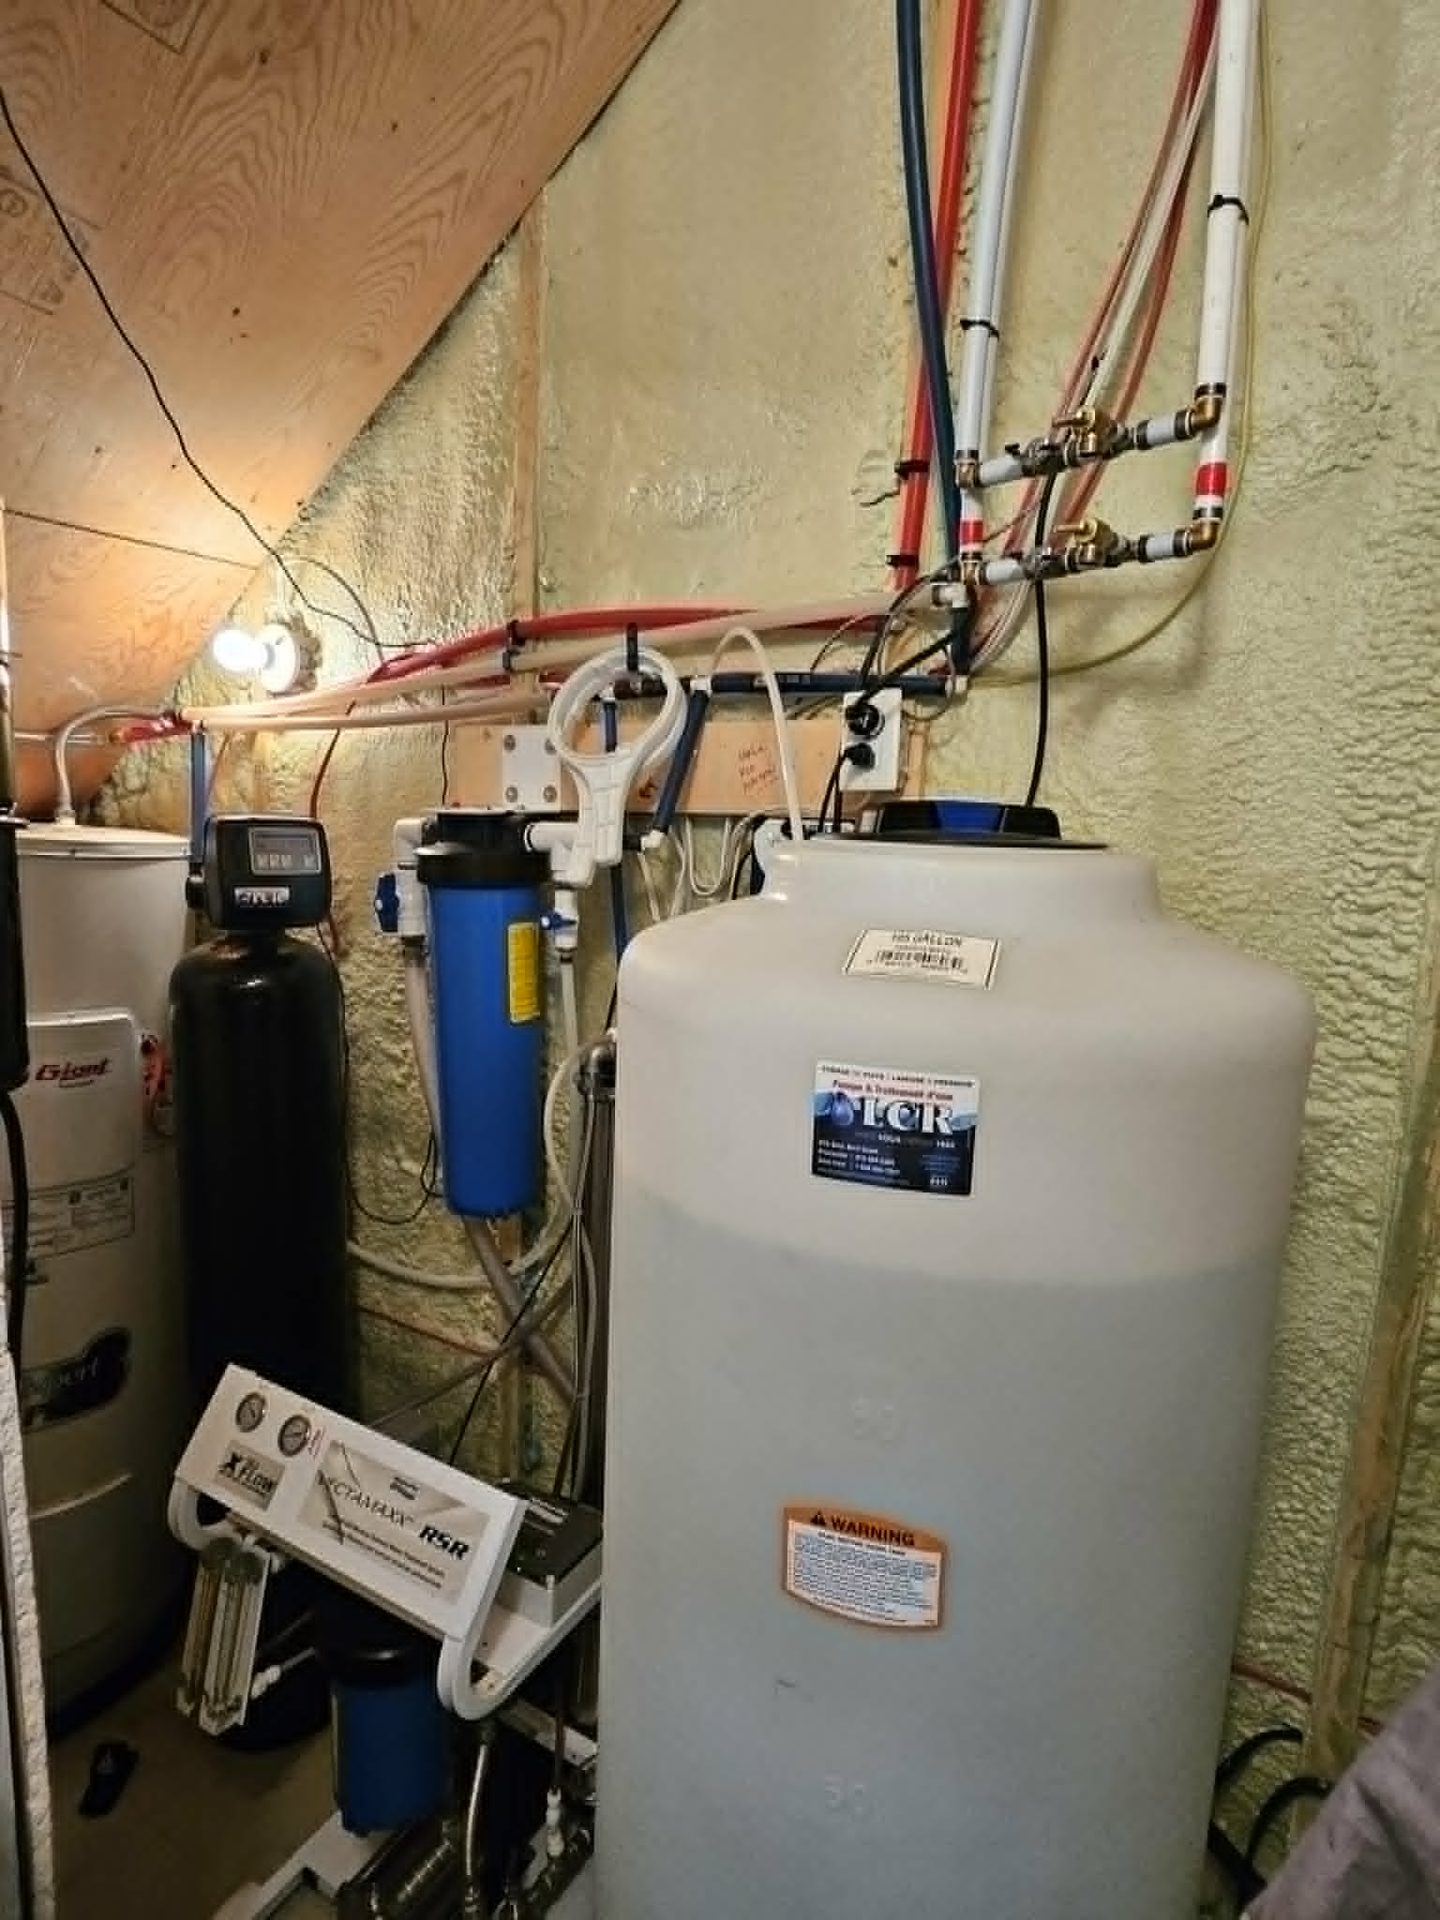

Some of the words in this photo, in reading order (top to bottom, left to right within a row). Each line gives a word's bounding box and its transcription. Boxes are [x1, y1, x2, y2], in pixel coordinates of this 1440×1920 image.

[35, 1057, 109, 1080] Giant
[858, 1097, 953, 1135] LCR
[418, 1524, 470, 1561] RSR
[831, 1515, 915, 1546] WARNING
